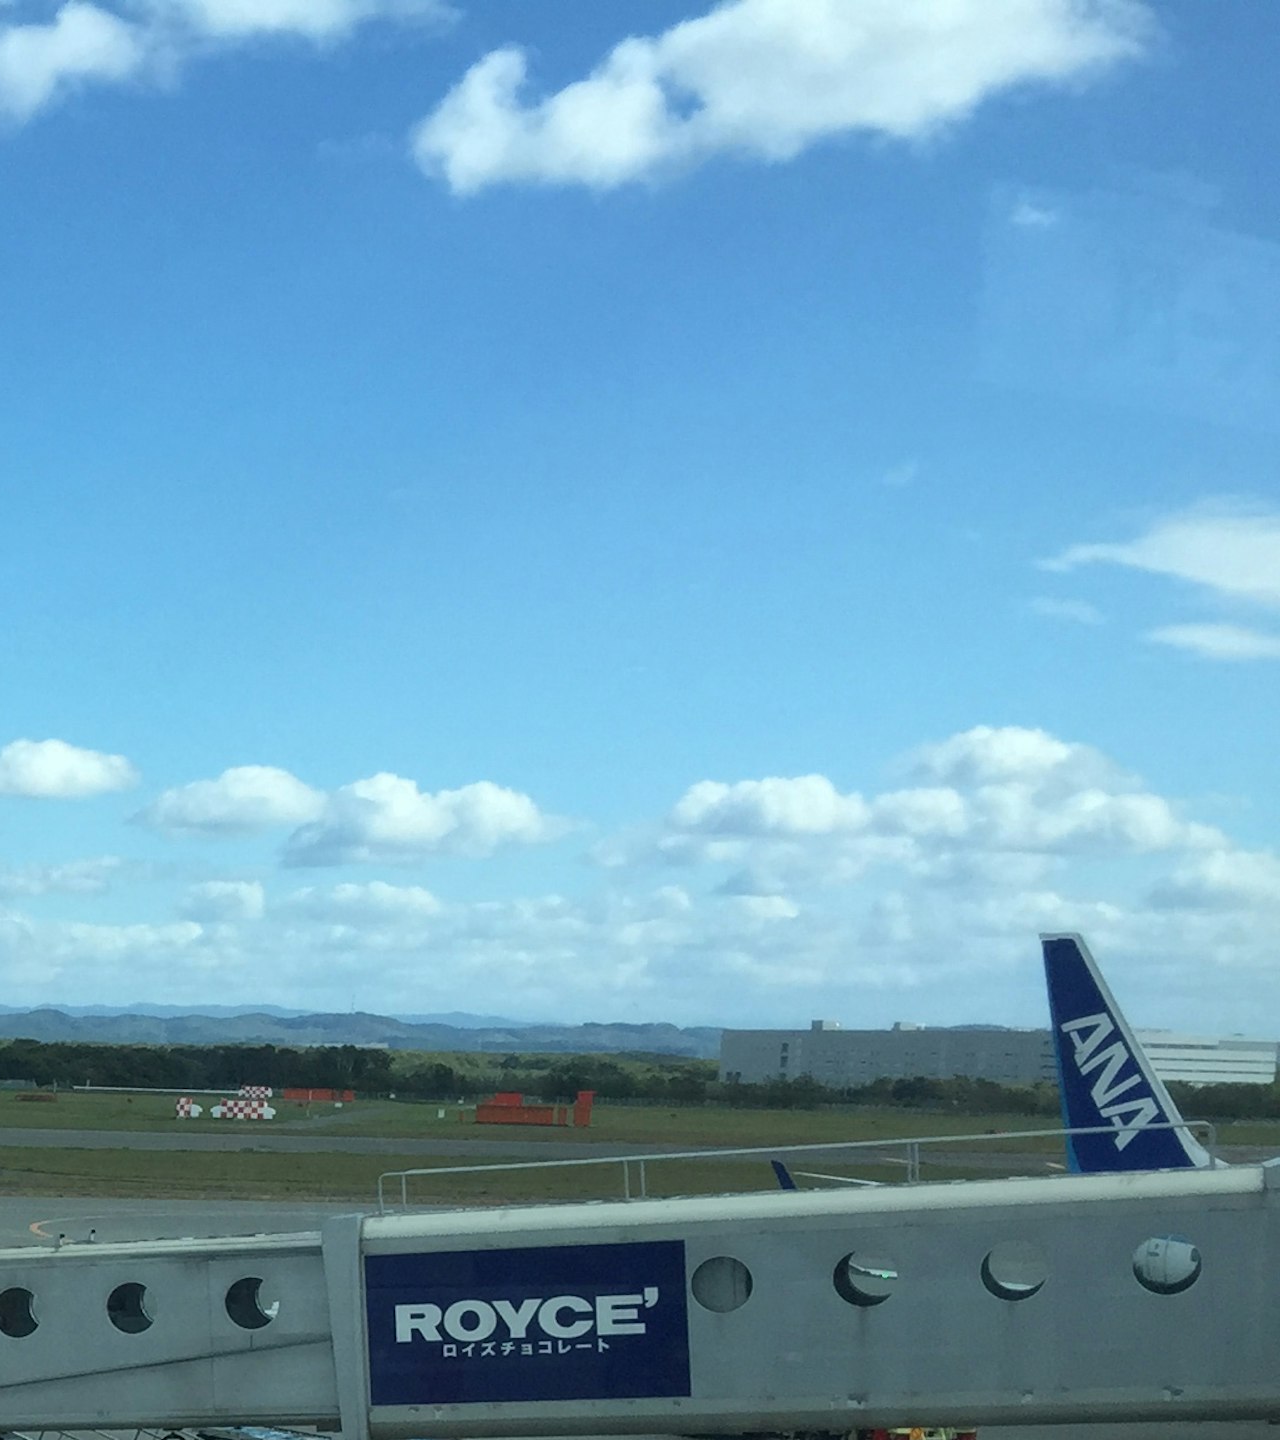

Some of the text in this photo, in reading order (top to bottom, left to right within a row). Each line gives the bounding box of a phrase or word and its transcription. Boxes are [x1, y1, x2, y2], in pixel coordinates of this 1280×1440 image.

[1061, 1012, 1159, 1152] ANA
[443, 1338, 610, 1357] ロイズチョコレート
